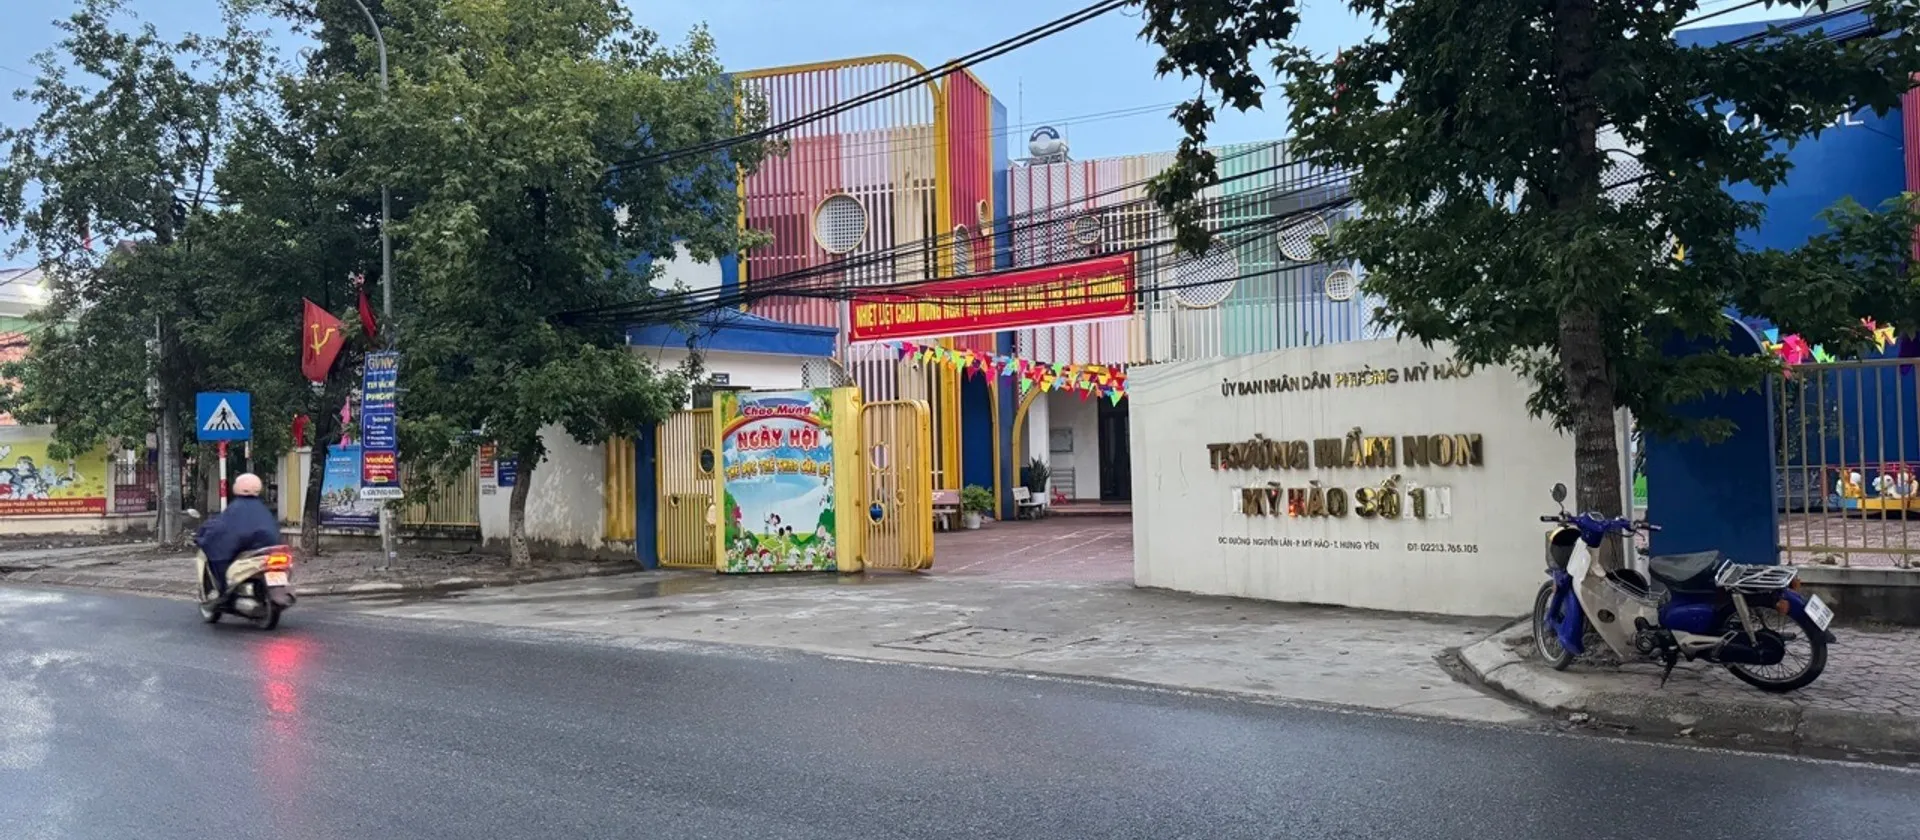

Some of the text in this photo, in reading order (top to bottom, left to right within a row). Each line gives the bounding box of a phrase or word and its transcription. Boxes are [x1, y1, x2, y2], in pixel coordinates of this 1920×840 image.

[1237, 380, 1262, 396] BAN
[1263, 373, 1299, 394] NHÂN
[1301, 370, 1331, 391] DÂN
[1335, 364, 1399, 388] PHƯỜNG
[1403, 361, 1430, 382] MỸ
[737, 424, 819, 451] NGÀY HỘI
[1206, 432, 1309, 471] TRƯỜNG
[1402, 433, 1485, 468] NON
[1241, 480, 1283, 519] MỸ
[1287, 479, 1349, 519] HÀO
[1355, 473, 1401, 520] SỐ
